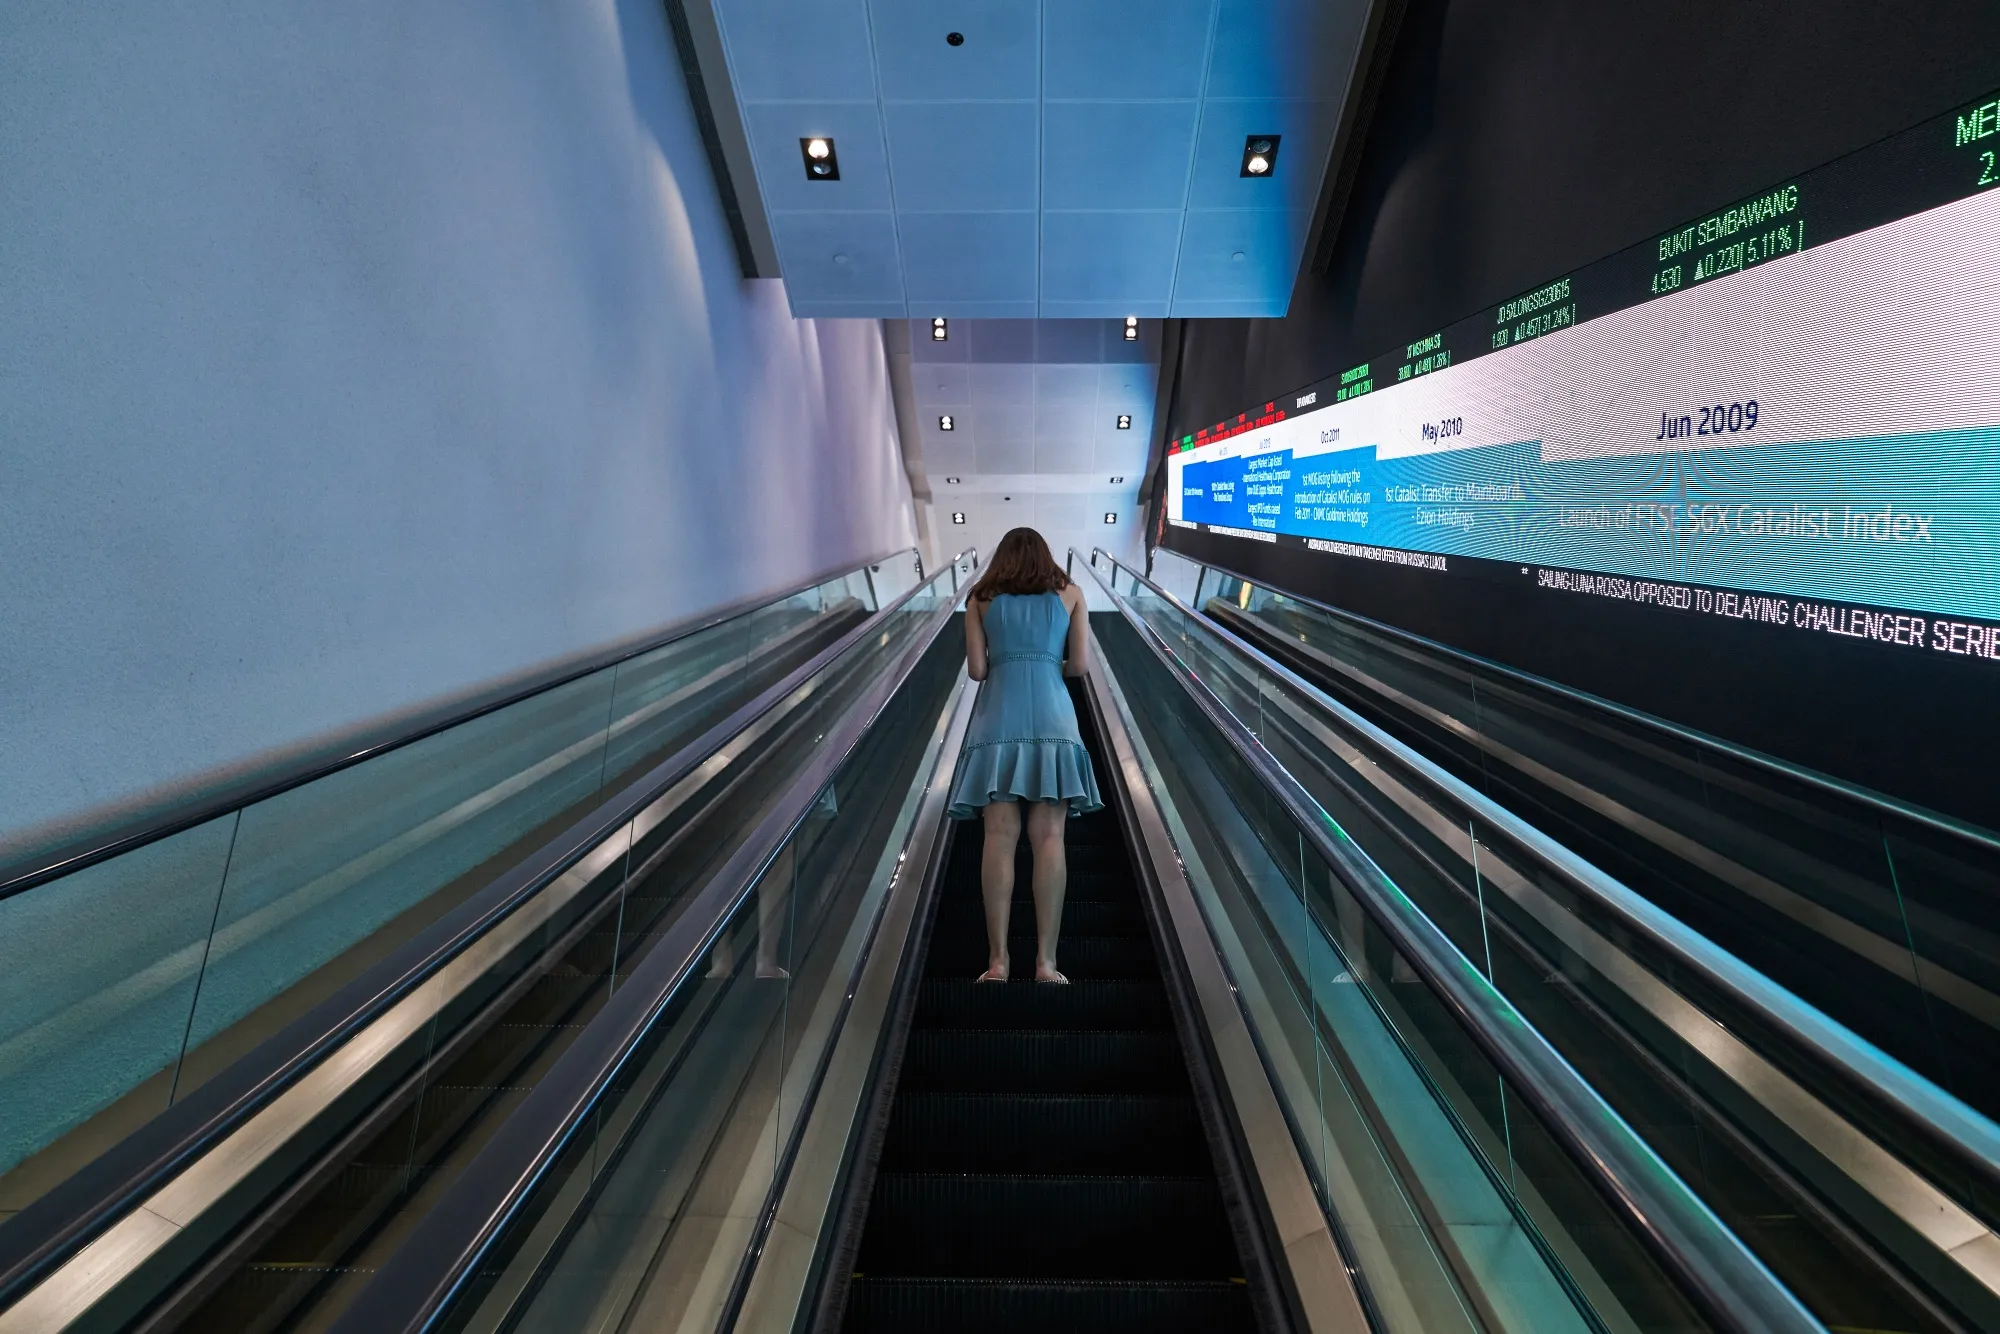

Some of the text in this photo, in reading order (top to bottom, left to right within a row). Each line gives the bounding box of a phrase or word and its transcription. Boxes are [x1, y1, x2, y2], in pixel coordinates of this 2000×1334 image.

[1956, 99, 2000, 147] ME
[1659, 185, 1798, 261] BUKIT SEMBAWANG
[1651, 265, 1682, 294] 4.530
[1748, 224, 1792, 262] 5.11%
[1421, 417, 1462, 445] May 2010
[1656, 400, 1760, 440] Jun 2009
[1320, 427, 1340, 444] Oct 2011
[1317, 472, 1330, 489] listing
[1331, 470, 1351, 488] following
[1351, 467, 1361, 484] the
[1385, 479, 1521, 502] 1st Catalist Transfer to Mainboard
[1294, 490, 1316, 504] introduction
[1321, 489, 1337, 504] Catalist
[1349, 488, 1361, 504] rules
[1362, 491, 1371, 504] on
[1294, 506, 1302, 520] Feb
[1326, 507, 1346, 523] Goldmine
[1346, 508, 1369, 528] Holdings
[1416, 507, 1436, 525] Ezion
[1438, 508, 1475, 532] Holdings
[1559, 502, 1934, 543] Launch of FTSE SGX Catalist Index
[1382, 548, 1395, 563] OFFER
[1395, 550, 1408, 565] FROM
[1538, 568, 1595, 595] SAILING-LUNA
[1596, 576, 1632, 601] ROSSA
[1633, 581, 1691, 610] OPPOSED
[1694, 588, 1712, 613] TO
[1715, 591, 1789, 625] DELAYING
[1793, 602, 1926, 648] CHALLENGER
